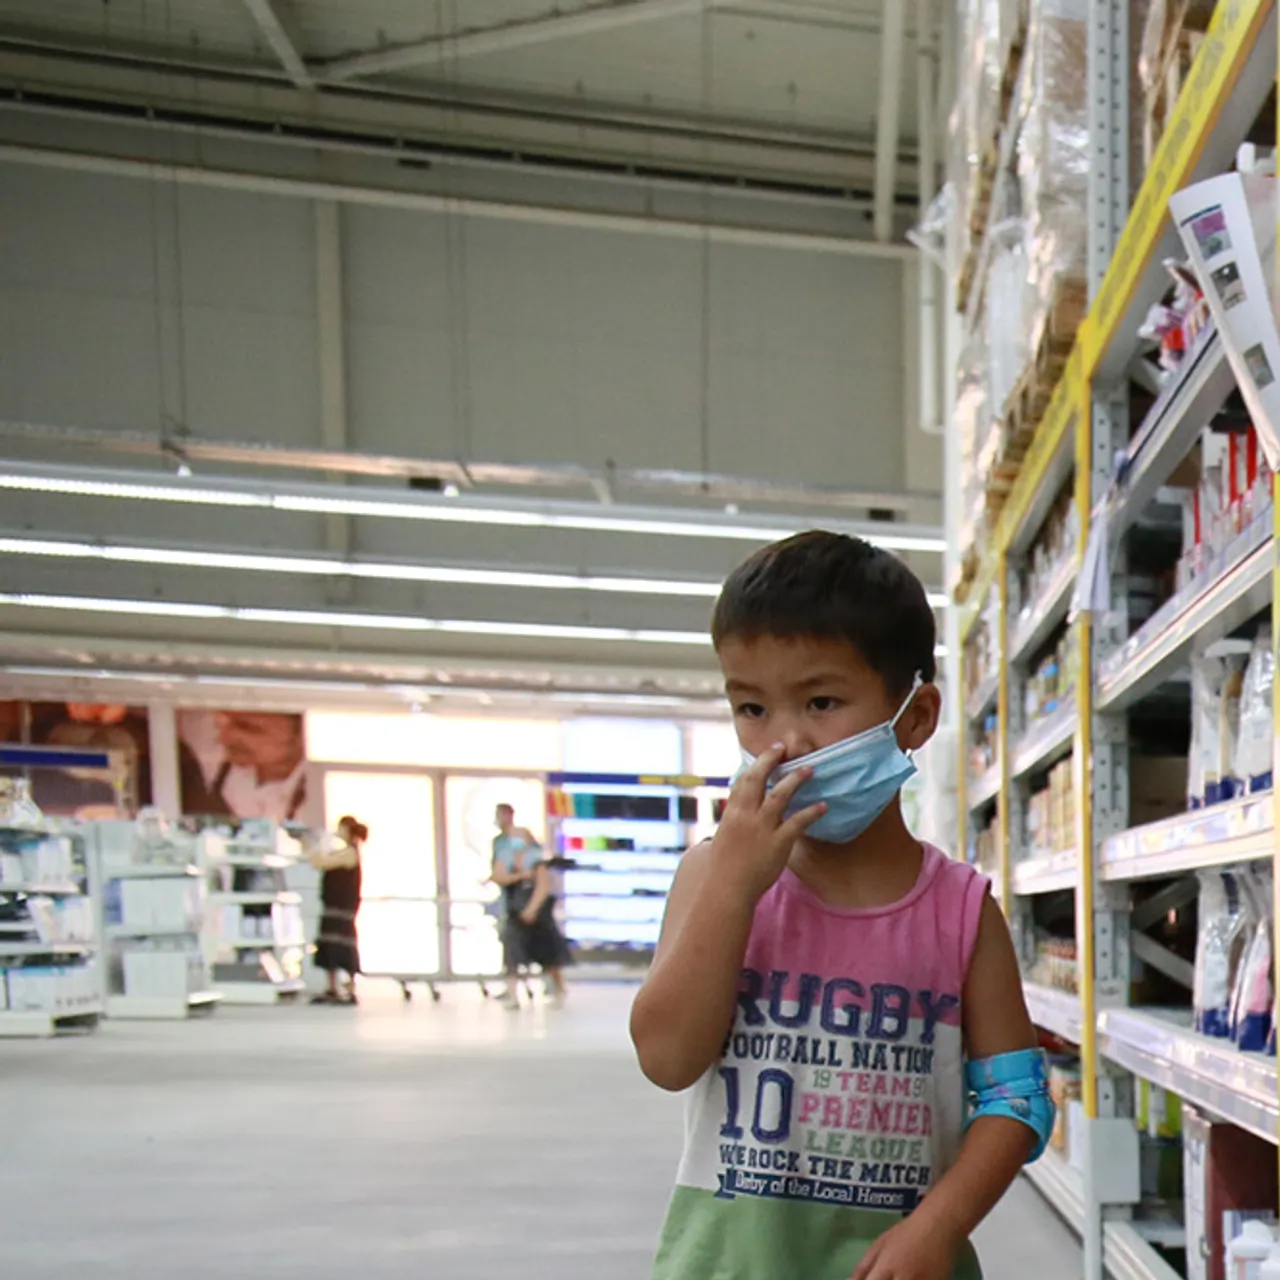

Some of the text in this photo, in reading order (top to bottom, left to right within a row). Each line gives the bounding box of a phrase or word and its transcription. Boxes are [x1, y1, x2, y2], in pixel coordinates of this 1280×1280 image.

[735, 967, 960, 1045] RUGBY
[850, 1042, 935, 1075] NATION
[836, 1072, 912, 1097] TEAM
[717, 1066, 795, 1145] 10
[797, 1091, 933, 1136] PREMIER
[804, 1131, 924, 1163] LEAGUE
[747, 1147, 800, 1173] ROCK
[808, 1156, 854, 1179] THE
[860, 1163, 931, 1187] MATCH
[813, 1181, 853, 1202] Local
